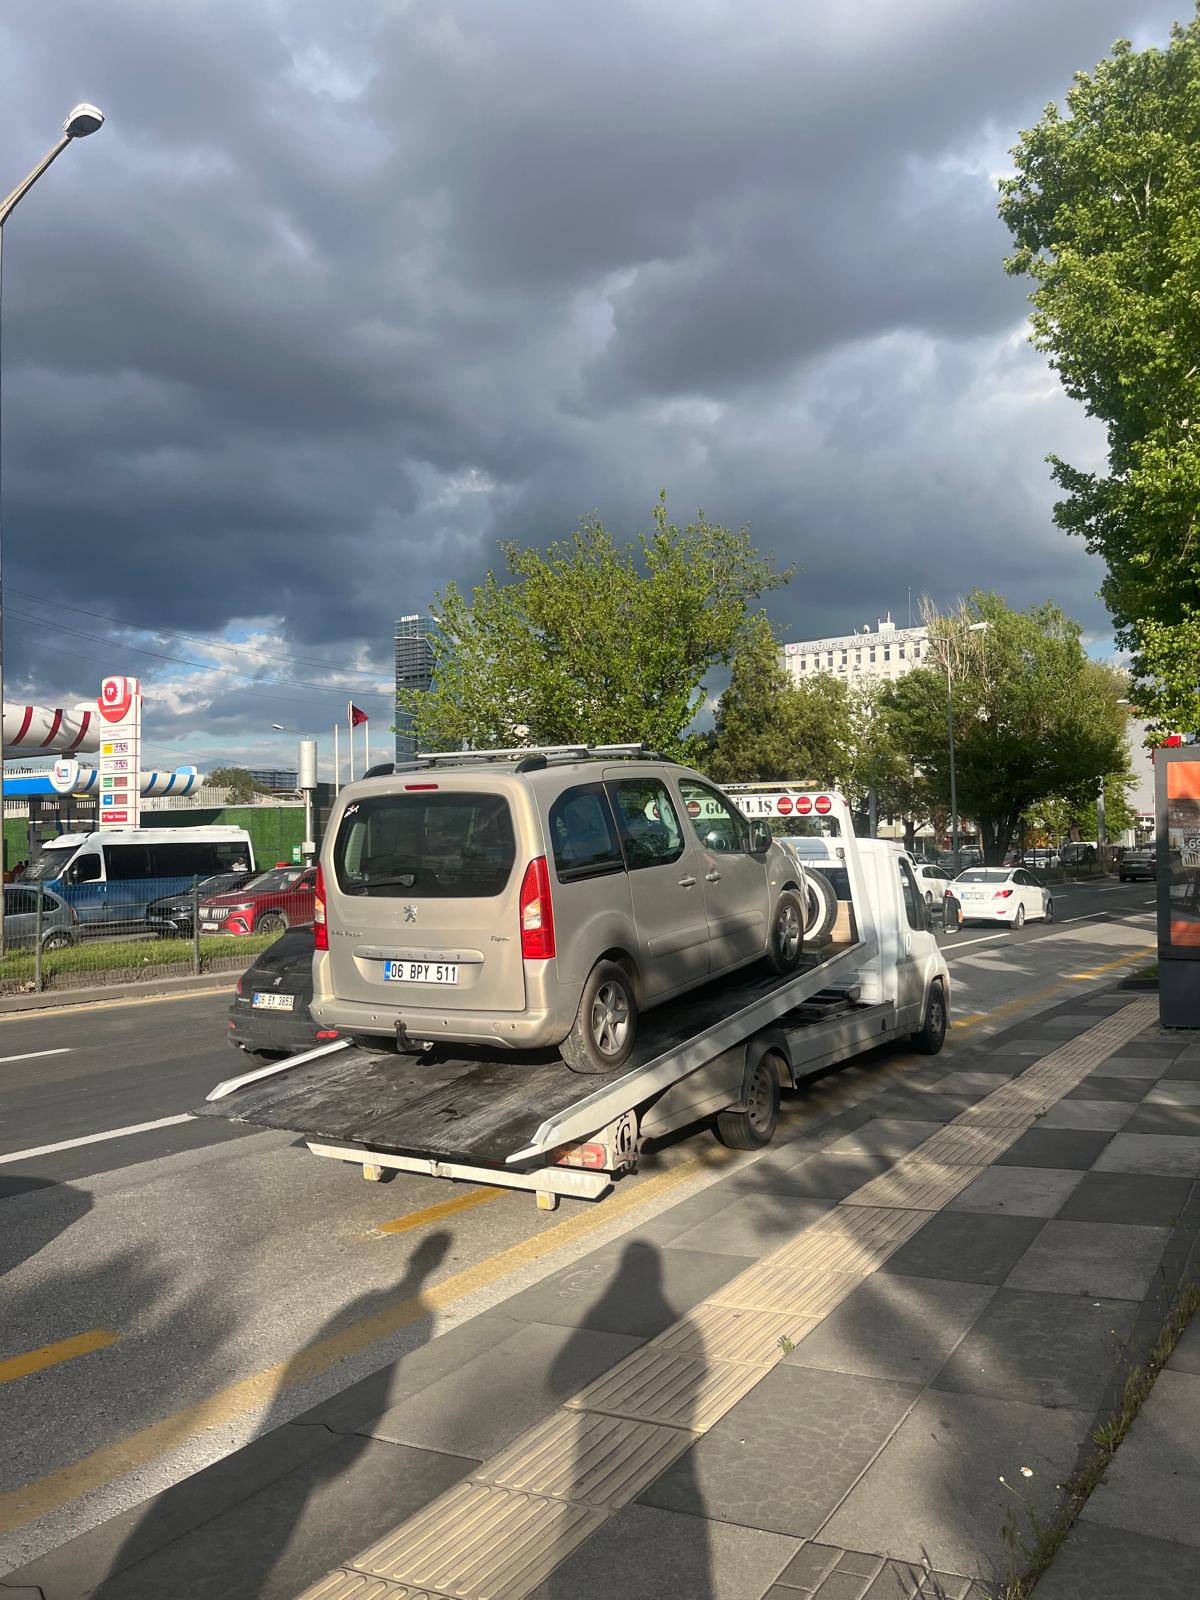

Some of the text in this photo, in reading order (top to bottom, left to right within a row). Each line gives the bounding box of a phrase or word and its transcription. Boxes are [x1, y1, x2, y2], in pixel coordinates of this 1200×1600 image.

[758, 797, 773, 815] İŞ
[391, 963, 456, 982] 06 BPY 511
